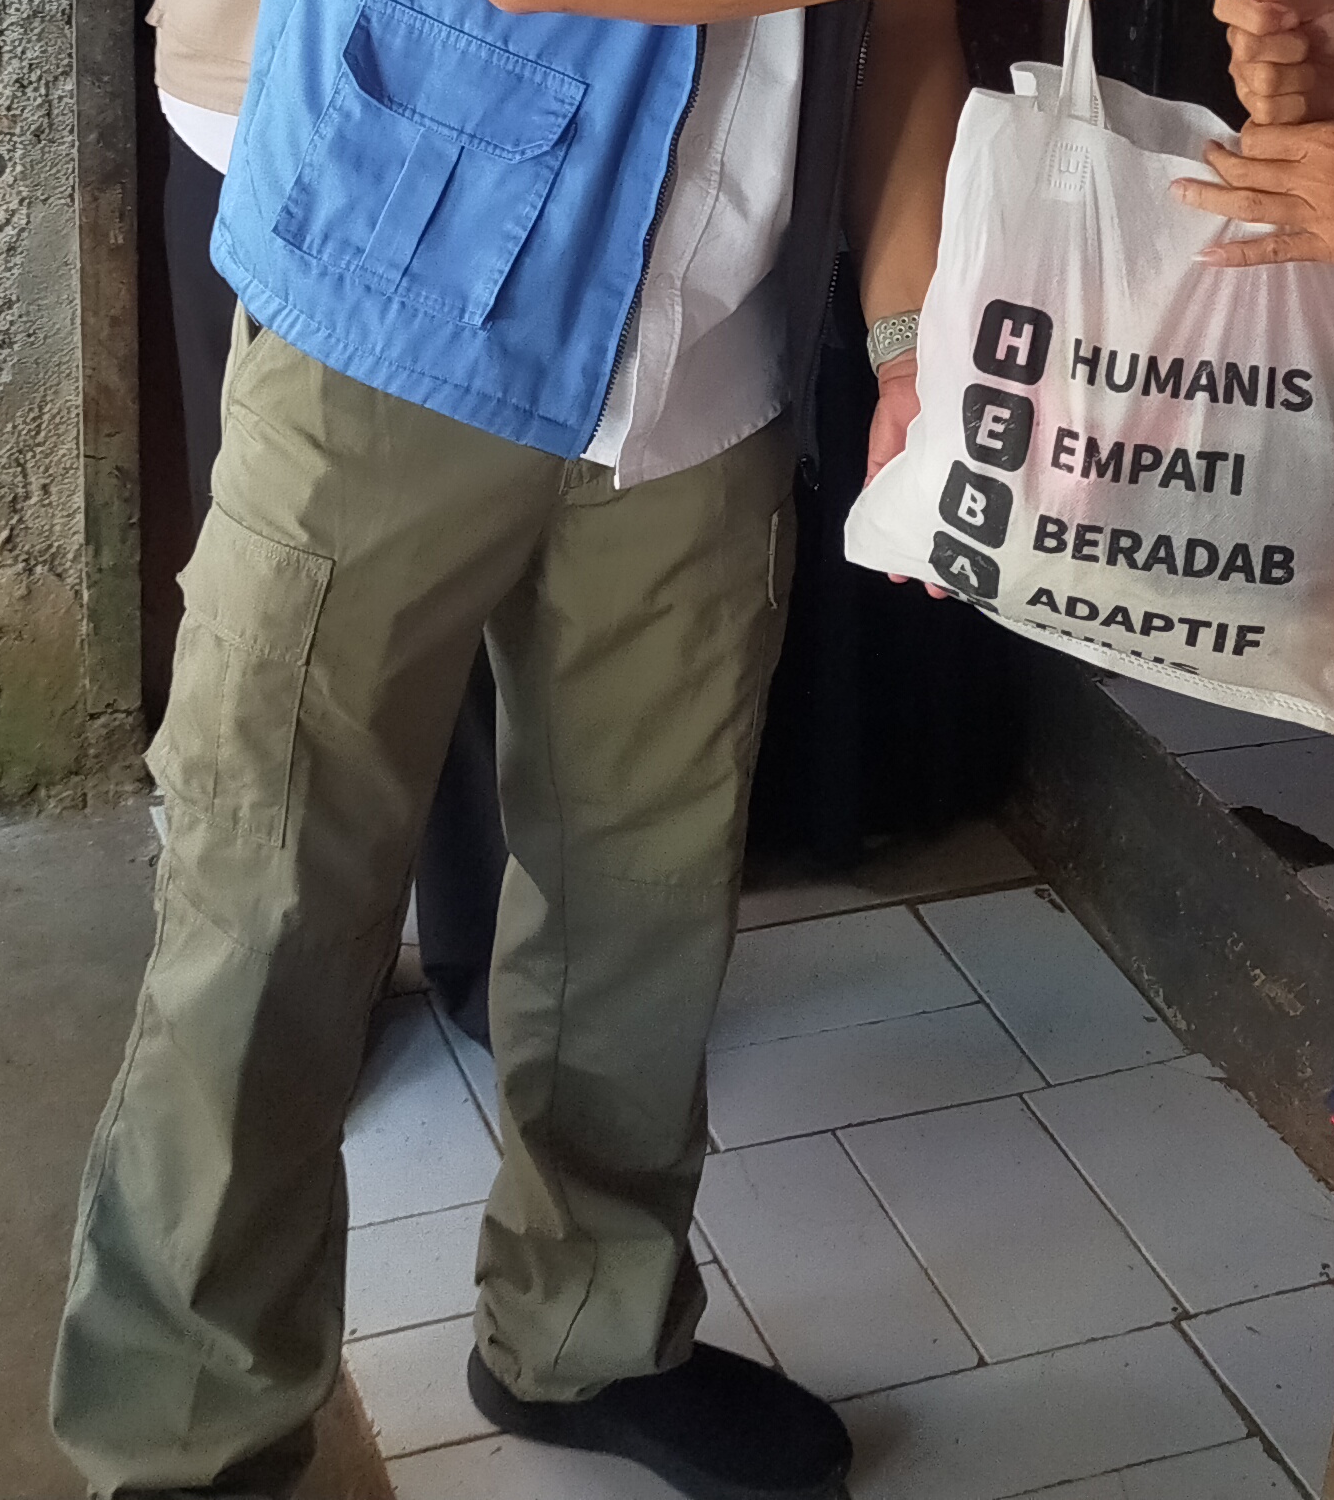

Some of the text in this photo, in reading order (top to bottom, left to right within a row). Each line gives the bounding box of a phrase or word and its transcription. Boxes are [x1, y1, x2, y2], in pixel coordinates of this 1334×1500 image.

[995, 318, 1314, 412] H HUMANIS
[976, 404, 1245, 496] E EMPATI
[958, 483, 1295, 585] B BERADAB
[949, 555, 979, 588] A
[1025, 587, 1265, 656] ADAPTIF
